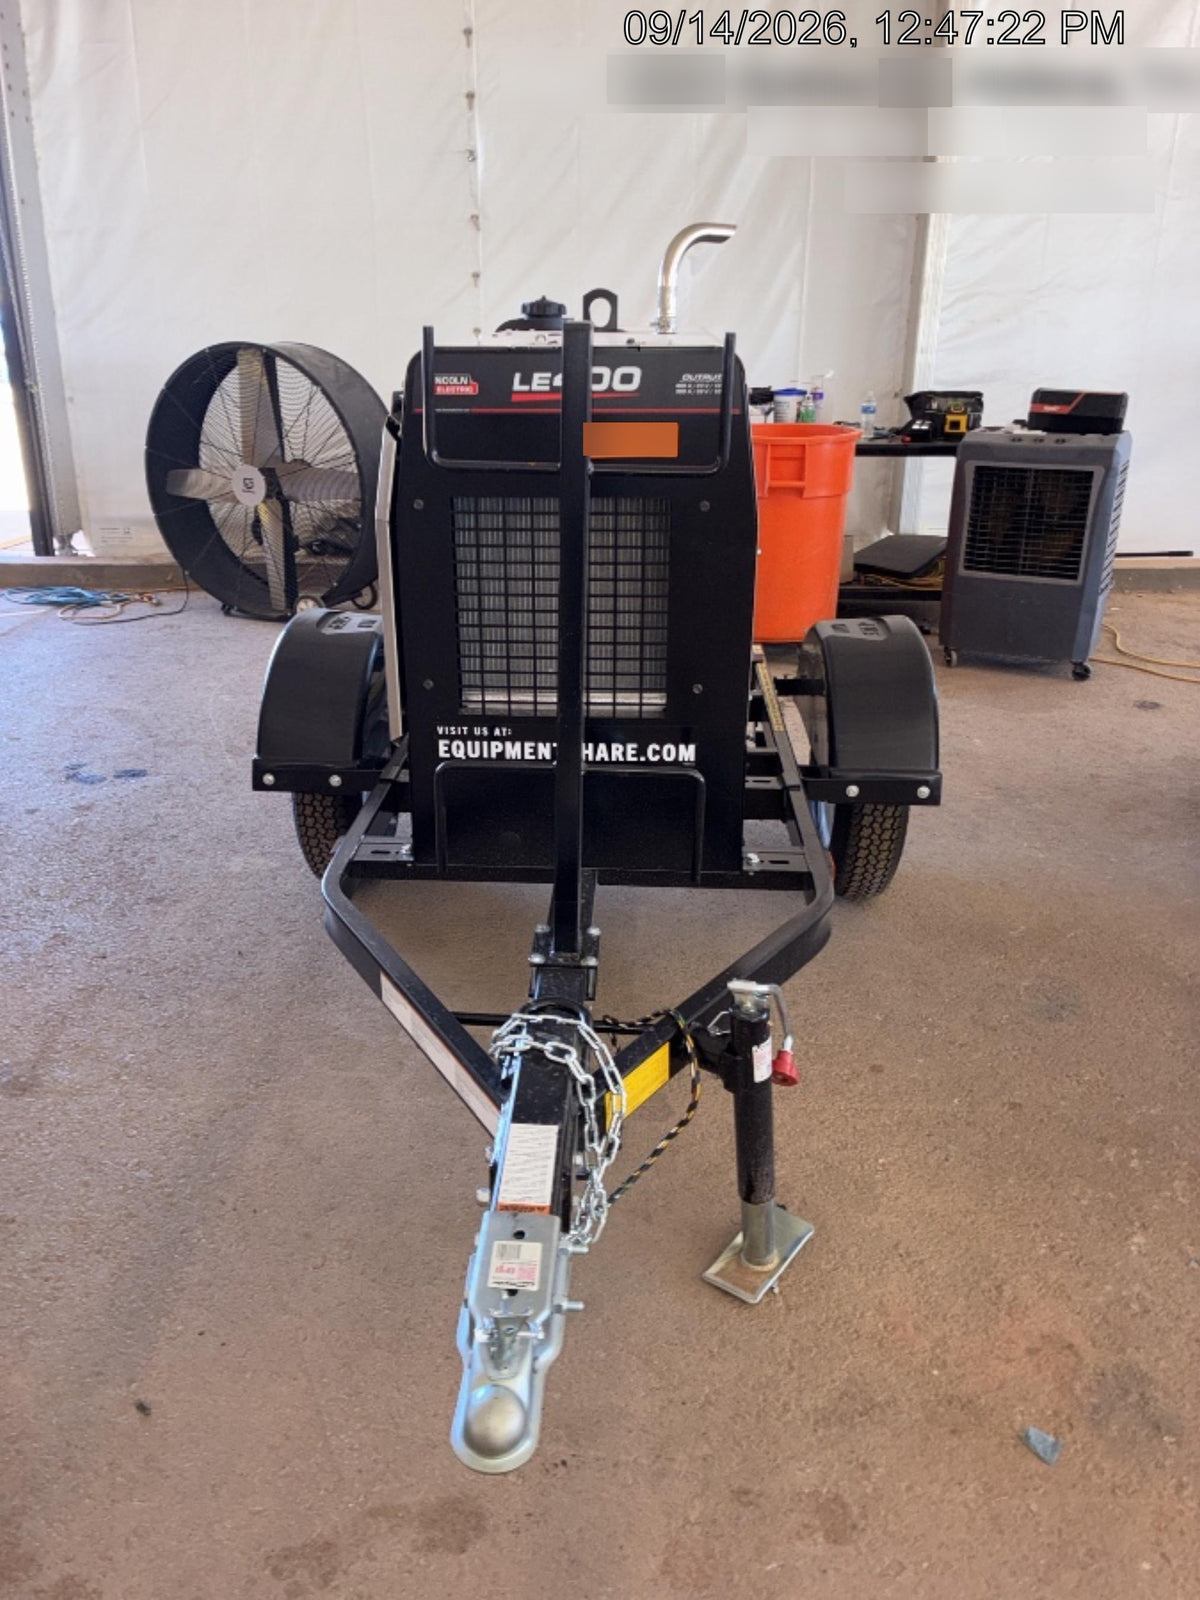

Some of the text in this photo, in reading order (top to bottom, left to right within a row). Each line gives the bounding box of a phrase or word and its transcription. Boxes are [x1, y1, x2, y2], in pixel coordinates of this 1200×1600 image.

[434, 376, 469, 384] NCOLN
[512, 366, 642, 392] LE00
[436, 725, 512, 737] VISIT US AT:
[438, 739, 696, 762] EQUIPMENHARE.COM
